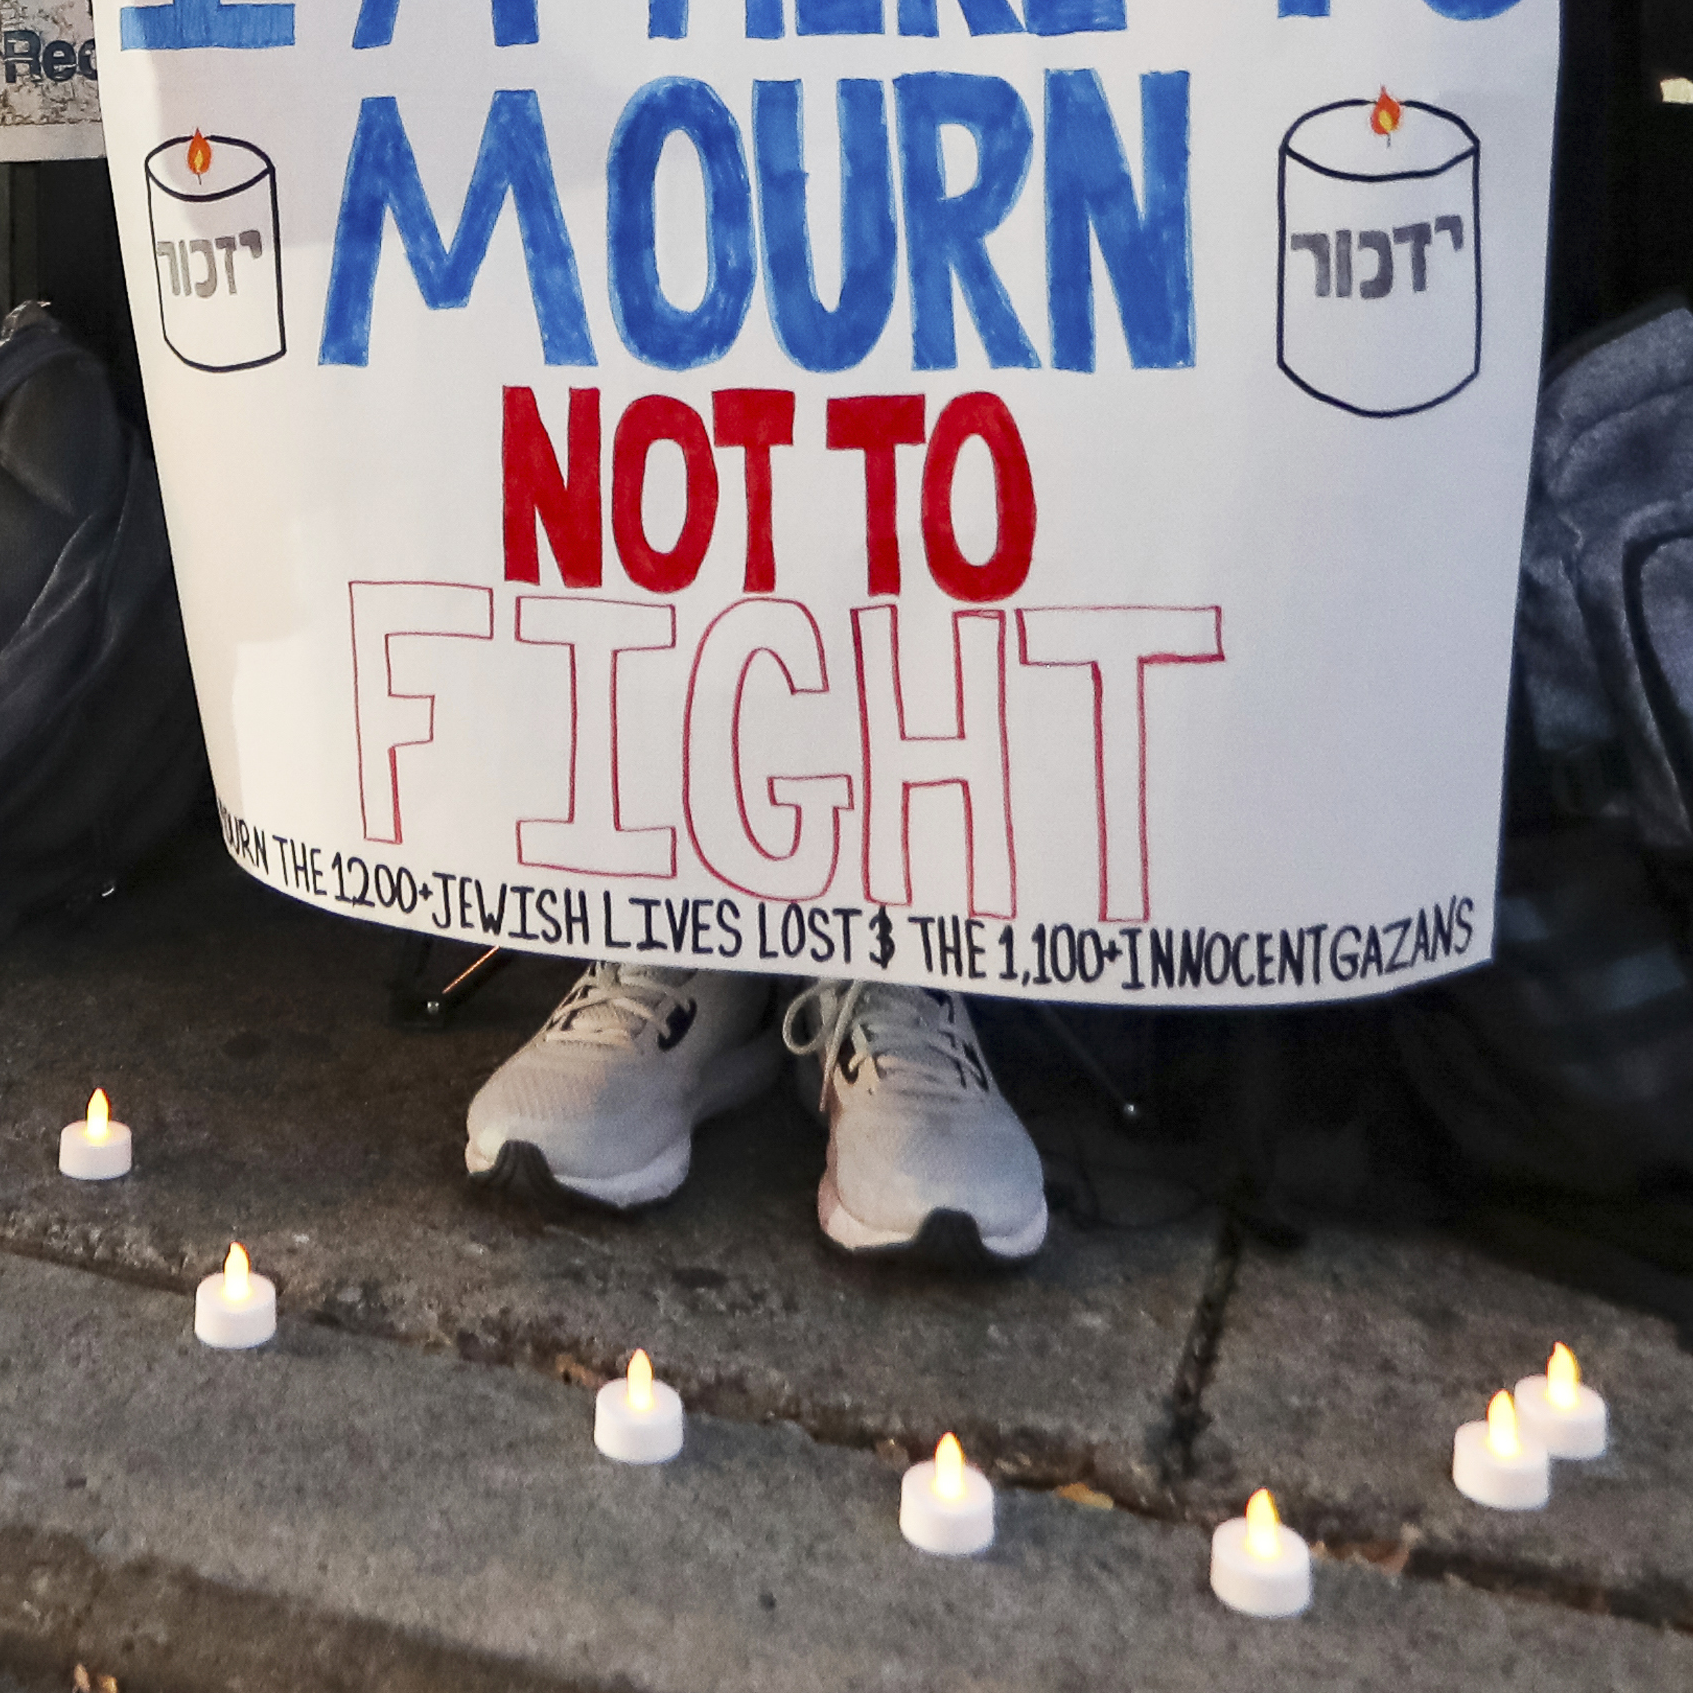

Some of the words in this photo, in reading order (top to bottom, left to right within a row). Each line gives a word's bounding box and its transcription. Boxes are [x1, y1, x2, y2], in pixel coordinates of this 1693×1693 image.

[317, 67, 1197, 374] MOURN
[502, 385, 796, 594] NOT
[825, 389, 1037, 603] TO
[347, 579, 1226, 924] FIGHT
[271, 834, 328, 896] THE
[602, 890, 743, 958] LIVES
[757, 900, 863, 964] LOST
[907, 914, 987, 980] THE
